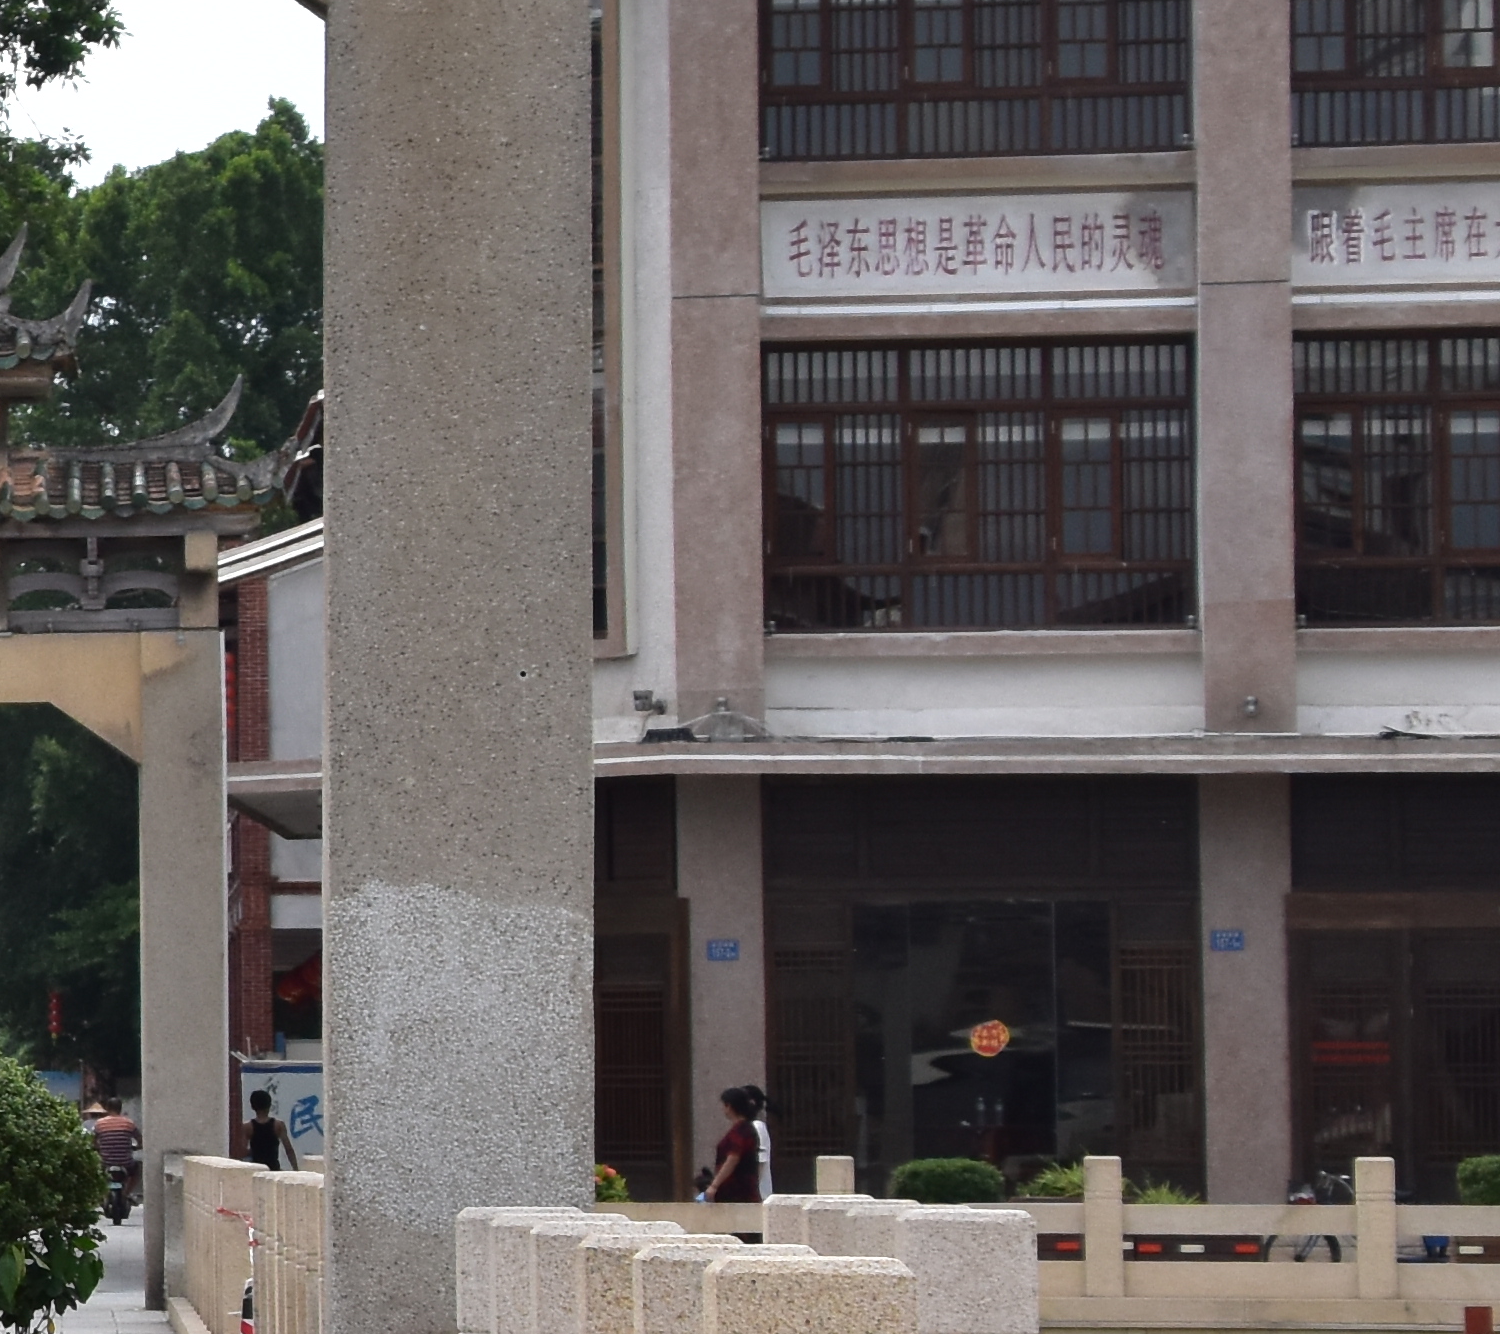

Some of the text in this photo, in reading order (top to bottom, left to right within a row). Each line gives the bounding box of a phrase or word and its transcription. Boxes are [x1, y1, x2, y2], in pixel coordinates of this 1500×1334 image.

[787, 212, 1166, 279] 毛泽东思想是革命人民的灵魂
[1308, 205, 1500, 265] 跟着毛主席在
